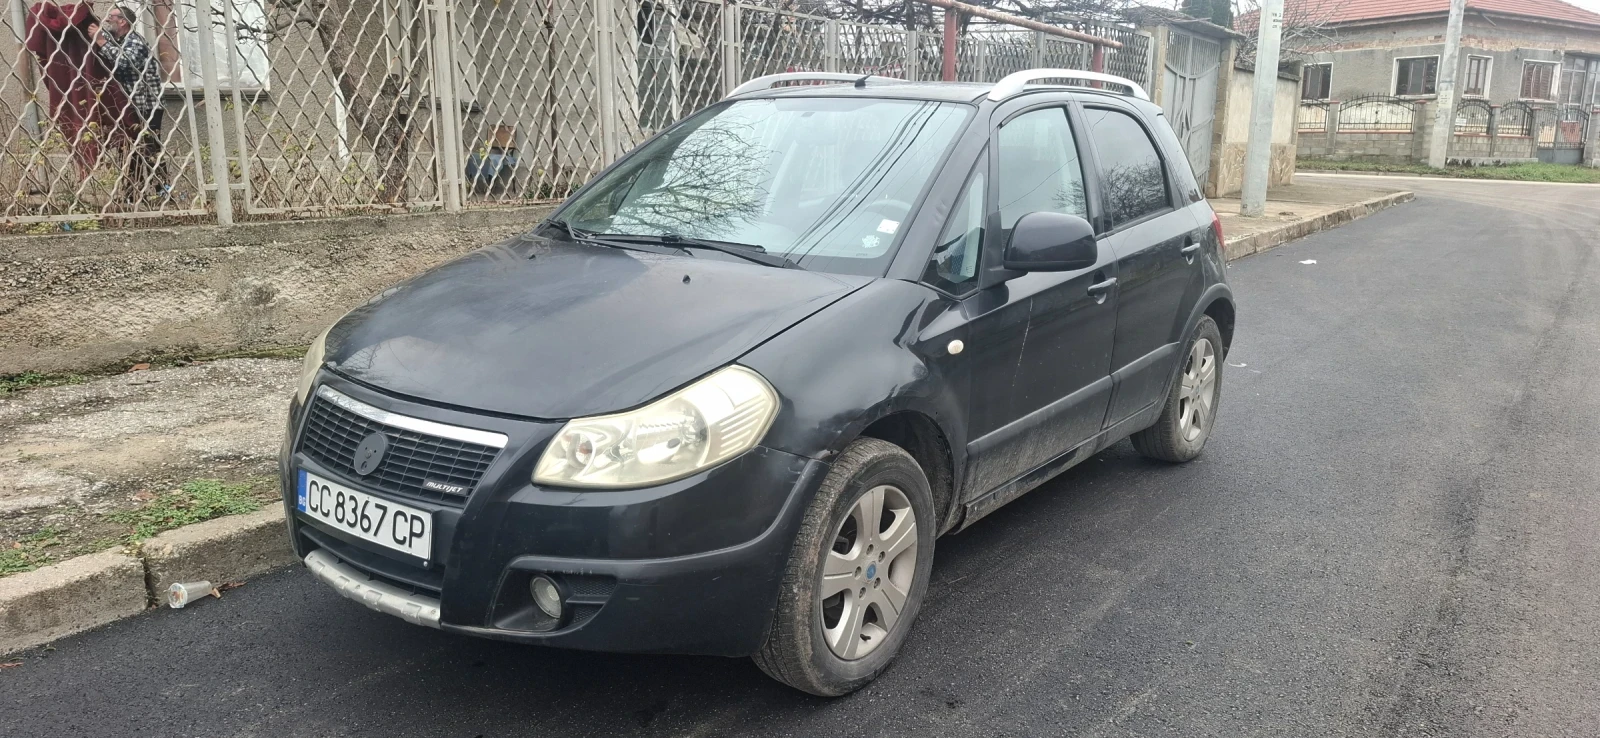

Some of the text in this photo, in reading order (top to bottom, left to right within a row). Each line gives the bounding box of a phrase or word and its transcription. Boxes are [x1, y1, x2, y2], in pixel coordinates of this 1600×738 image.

[426, 481, 463, 493] MULTIJET
[309, 480, 425, 548] CC 8367 CP
